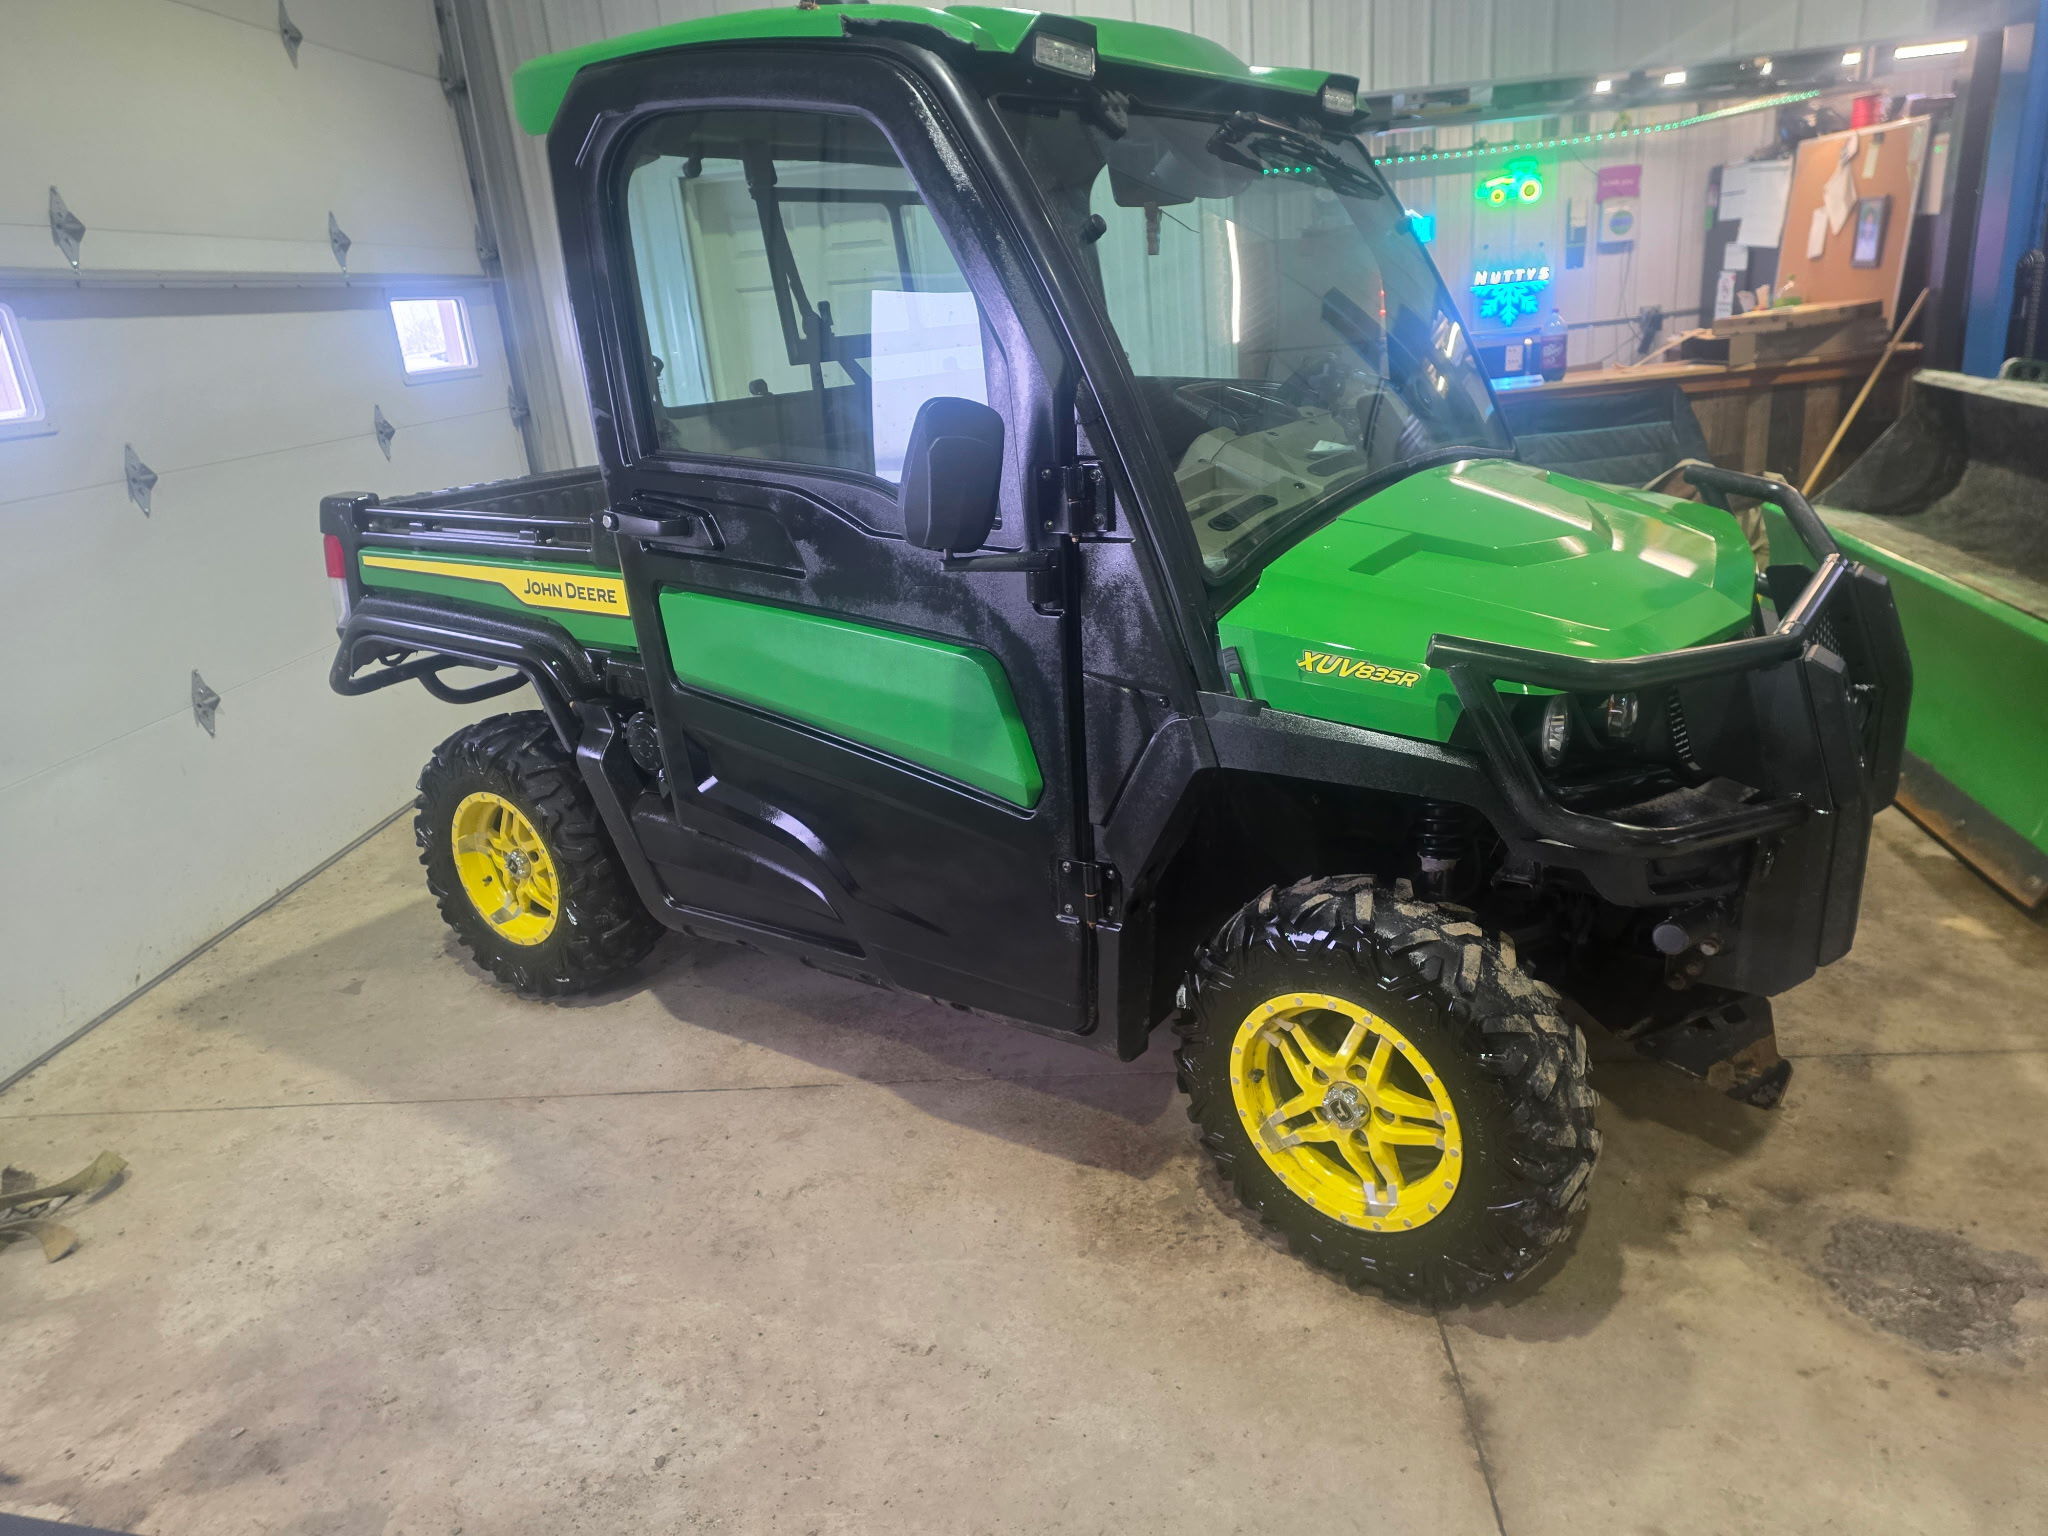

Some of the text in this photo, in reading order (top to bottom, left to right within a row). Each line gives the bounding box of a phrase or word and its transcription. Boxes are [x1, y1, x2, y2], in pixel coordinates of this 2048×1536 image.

[1473, 266, 1550, 286] NUTTYS
[523, 578, 618, 604] JOHN DEERE
[1297, 651, 1421, 688] XUV835R
